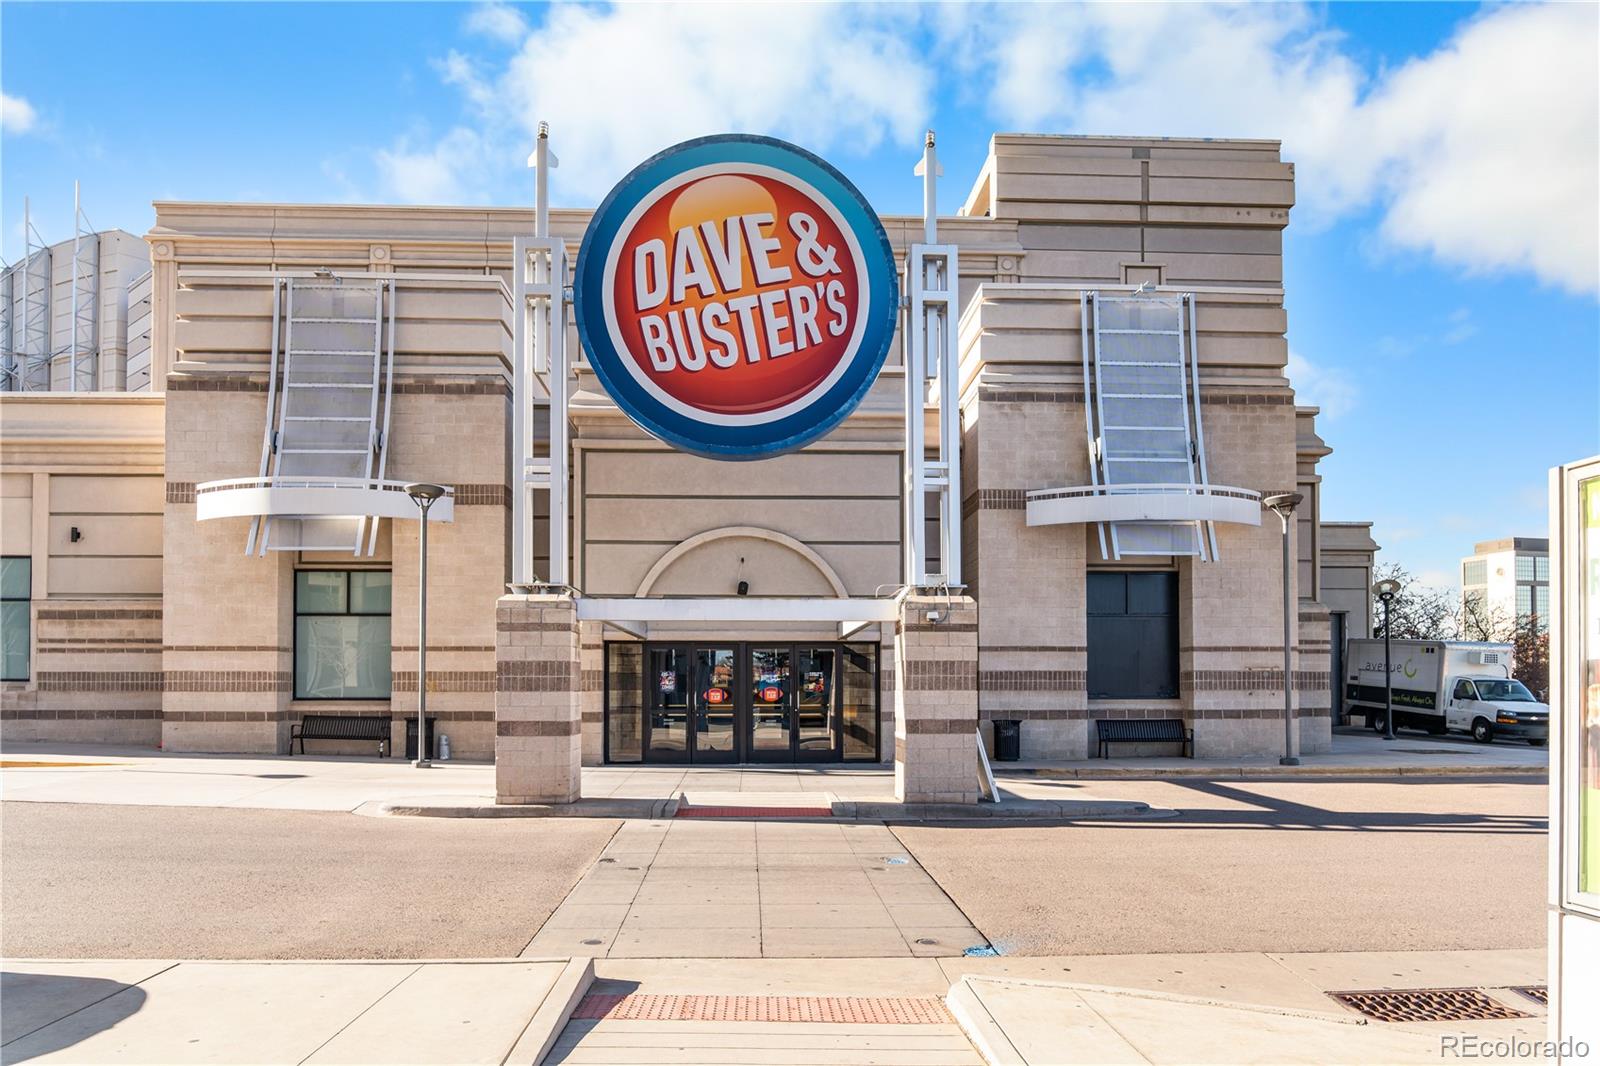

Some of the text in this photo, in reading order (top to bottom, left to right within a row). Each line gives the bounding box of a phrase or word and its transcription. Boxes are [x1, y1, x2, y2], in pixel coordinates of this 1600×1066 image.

[634, 212, 842, 312] DAVE &
[639, 280, 847, 372] BUSTER'S
